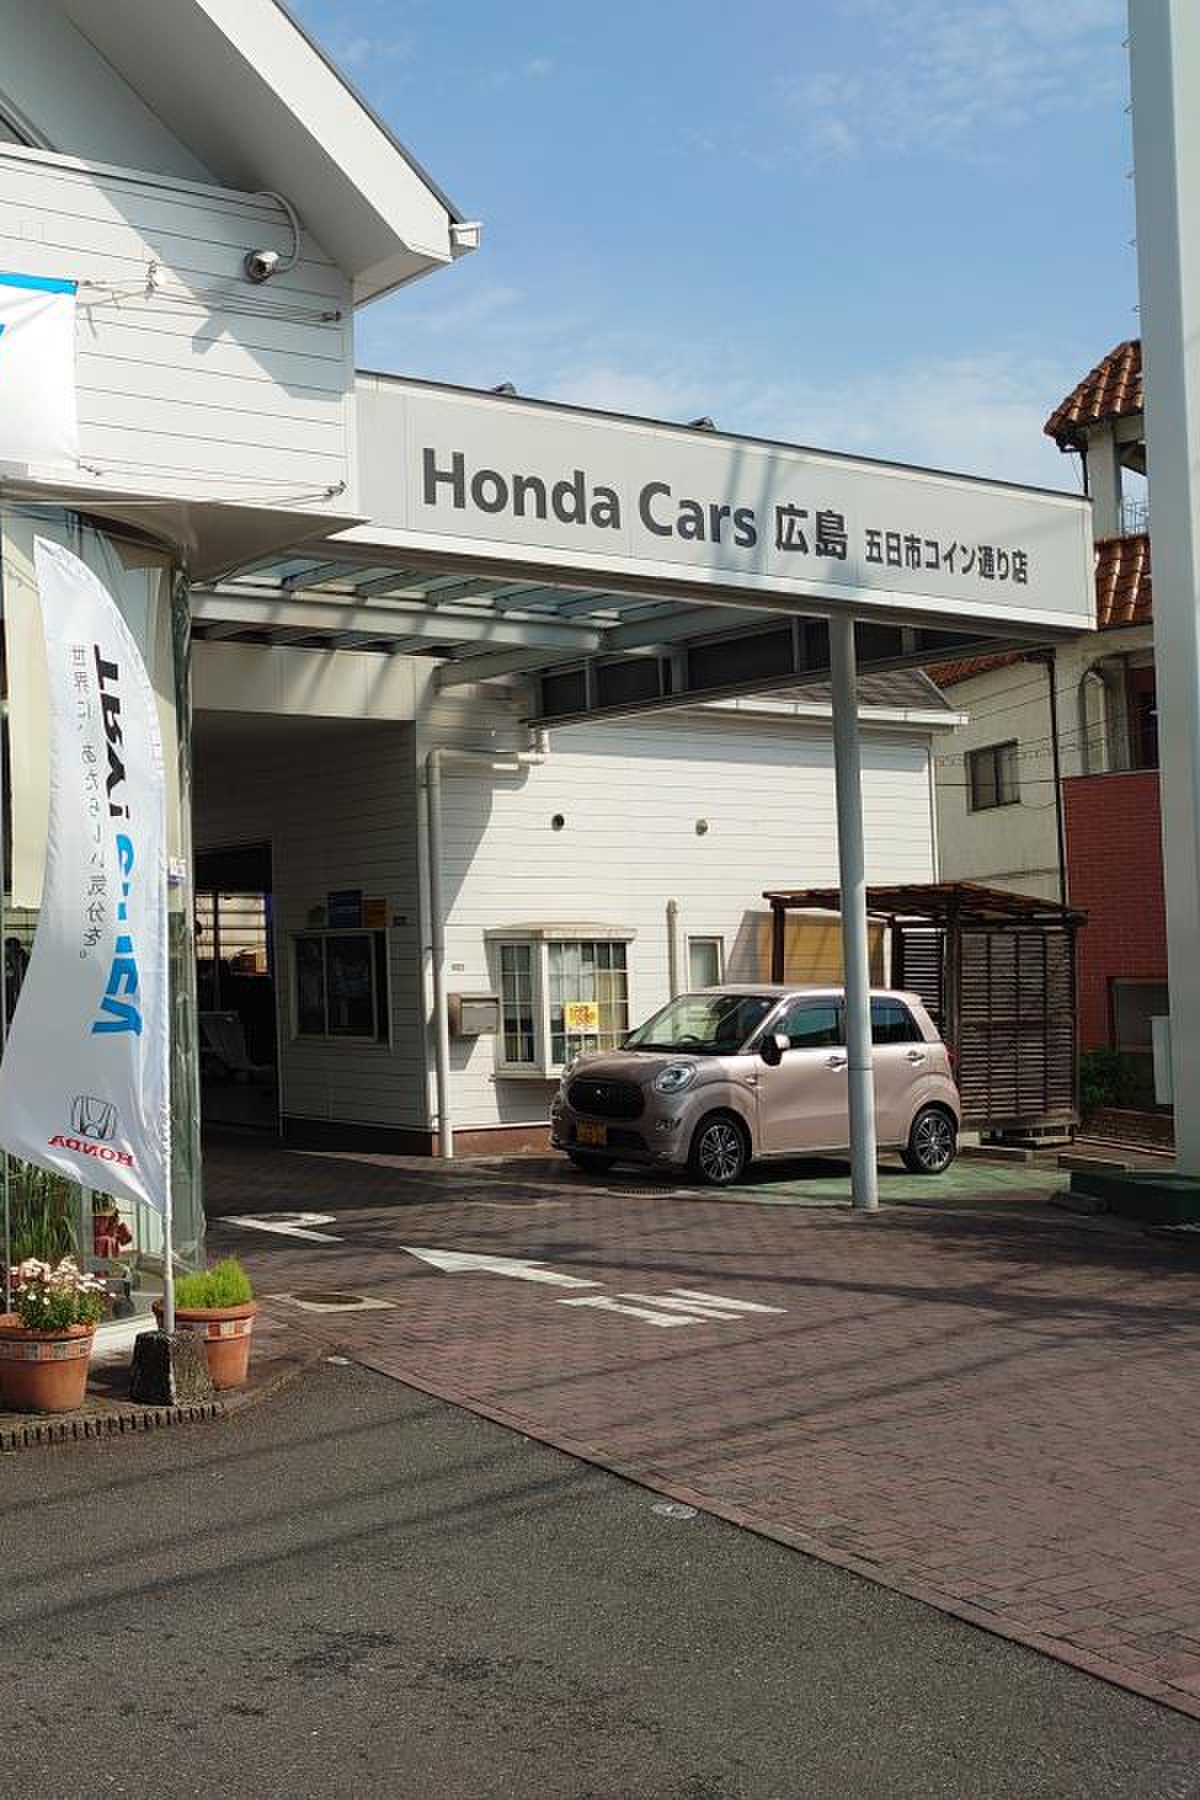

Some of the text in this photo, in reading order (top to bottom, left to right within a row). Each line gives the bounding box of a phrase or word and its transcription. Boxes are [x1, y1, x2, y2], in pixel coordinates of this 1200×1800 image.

[421, 447, 1029, 585] Honda Cars 広島 五日市コイン通り店
